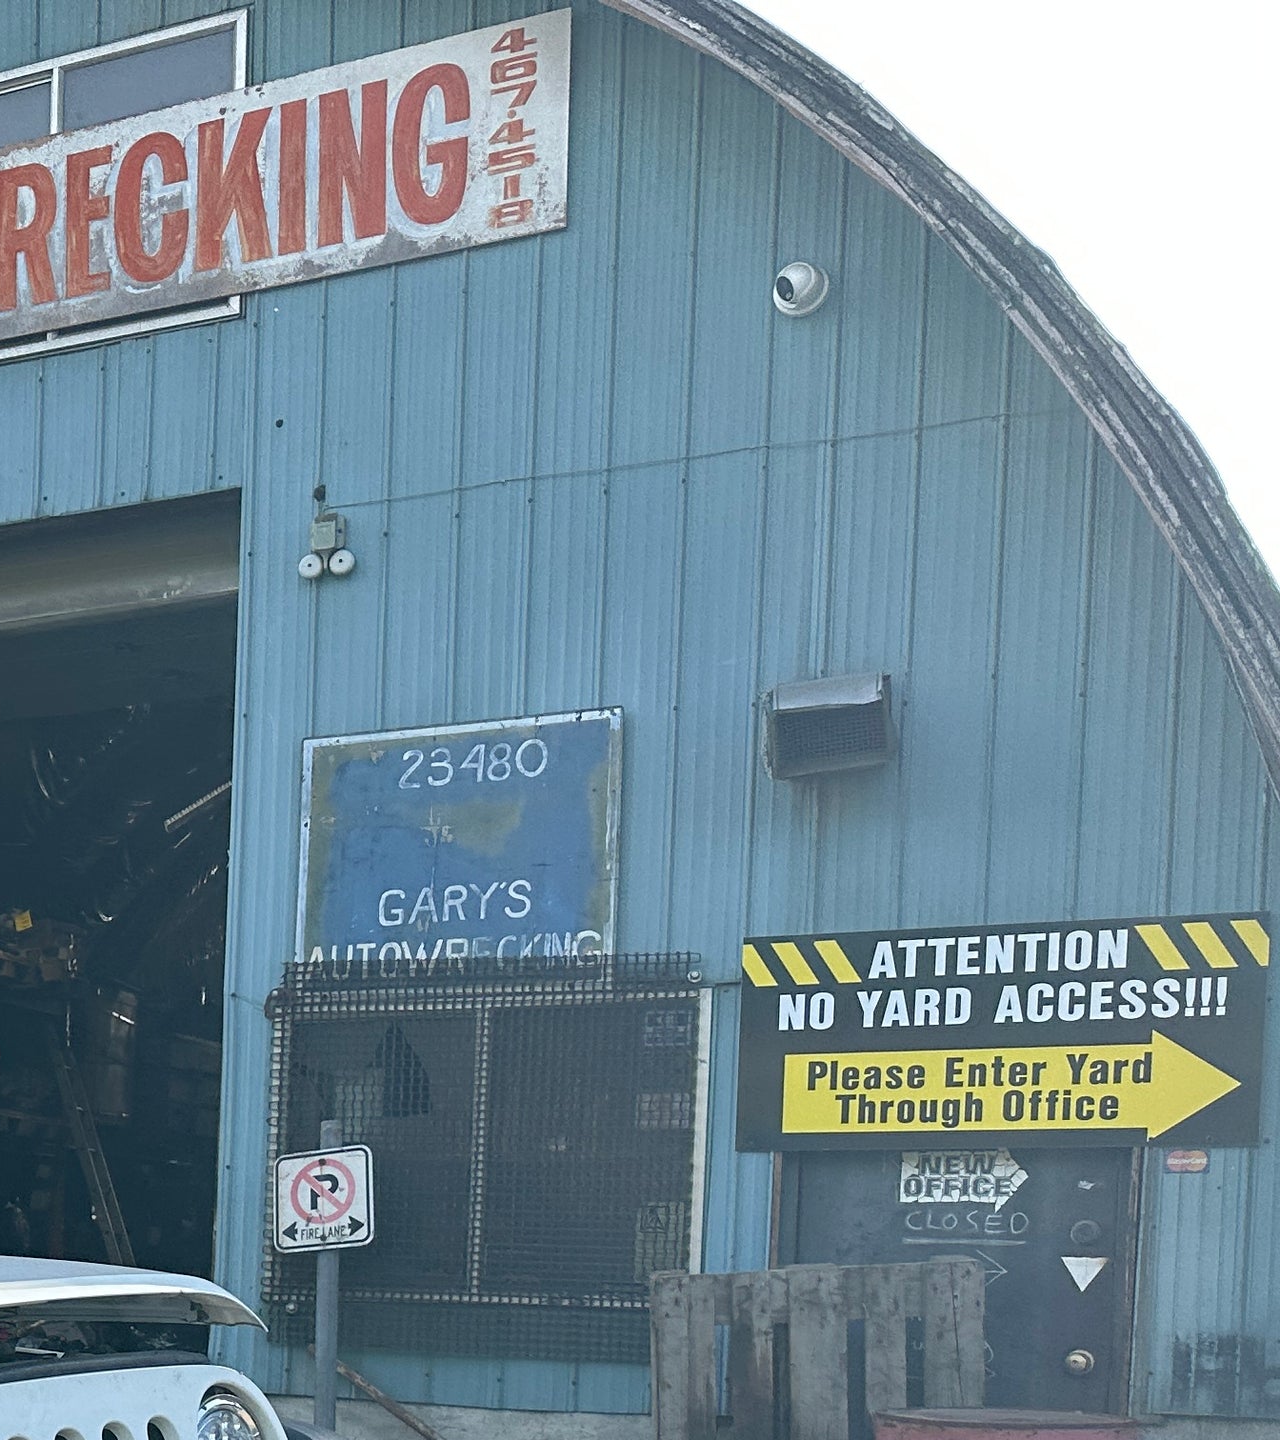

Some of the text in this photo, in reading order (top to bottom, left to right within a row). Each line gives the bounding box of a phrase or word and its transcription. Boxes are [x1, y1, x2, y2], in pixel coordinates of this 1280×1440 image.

[397, 738, 550, 790] 23480
[377, 879, 533, 928] GARY'S
[868, 928, 1129, 980] ATTENTION
[777, 975, 1229, 1031] NO YARD ACCESS!!!
[806, 1051, 1153, 1091] Please Enter Yard
[835, 1089, 1120, 1128] Through Office
[920, 1153, 996, 1175] NEW
[903, 1175, 1013, 1197] OFFICE
[300, 1227, 320, 1241] FIRE
[905, 1210, 1030, 1234] CLOSED
